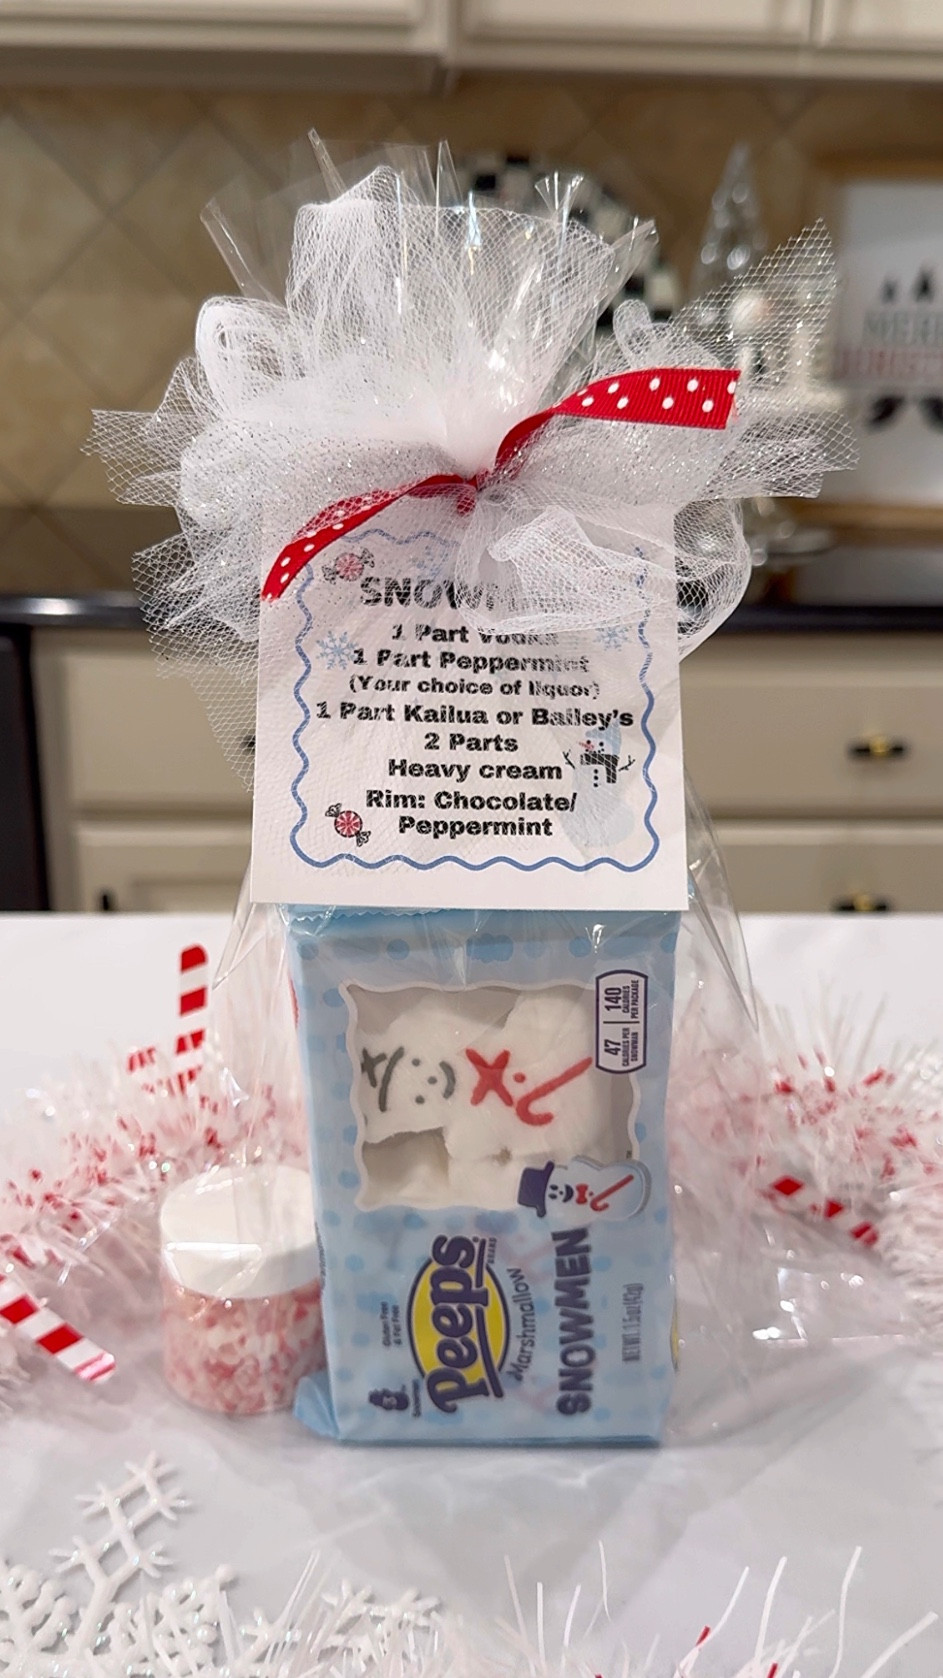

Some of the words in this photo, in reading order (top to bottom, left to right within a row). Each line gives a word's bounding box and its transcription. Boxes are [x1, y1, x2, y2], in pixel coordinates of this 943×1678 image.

[392, 624, 404, 641] 1
[415, 624, 469, 643] Part
[353, 648, 368, 665] 1
[376, 649, 431, 669] Part
[440, 651, 590, 675] Peppermint
[349, 674, 411, 694] (Your
[417, 677, 493, 696] choice
[500, 679, 523, 697] of
[529, 680, 600, 701] liquor)
[316, 702, 332, 720] 1
[340, 702, 395, 722] Part
[404, 704, 489, 725] Kailua
[496, 711, 524, 726] or
[531, 708, 635, 730] Bailey's
[424, 733, 440, 751] 2
[449, 733, 519, 752] Parts
[388, 759, 471, 783] Heavy
[479, 764, 563, 781] cream
[365, 789, 425, 809] Rim:
[434, 790, 578, 813] Chocolate/
[399, 815, 553, 840] Peppermint
[604, 986, 622, 1012] 140
[622, 985, 630, 1013] CALORIES
[631, 979, 640, 1008] PACKAGE
[631, 1009, 639, 1019] PER
[622, 1027, 630, 1039] PER
[604, 1038, 621, 1056] 47
[622, 1040, 630, 1067] CALORIES
[426, 1234, 489, 1413] Peeps
[506, 1267, 536, 1382] Marshmallow
[551, 1227, 596, 1416] SNOWMEN
